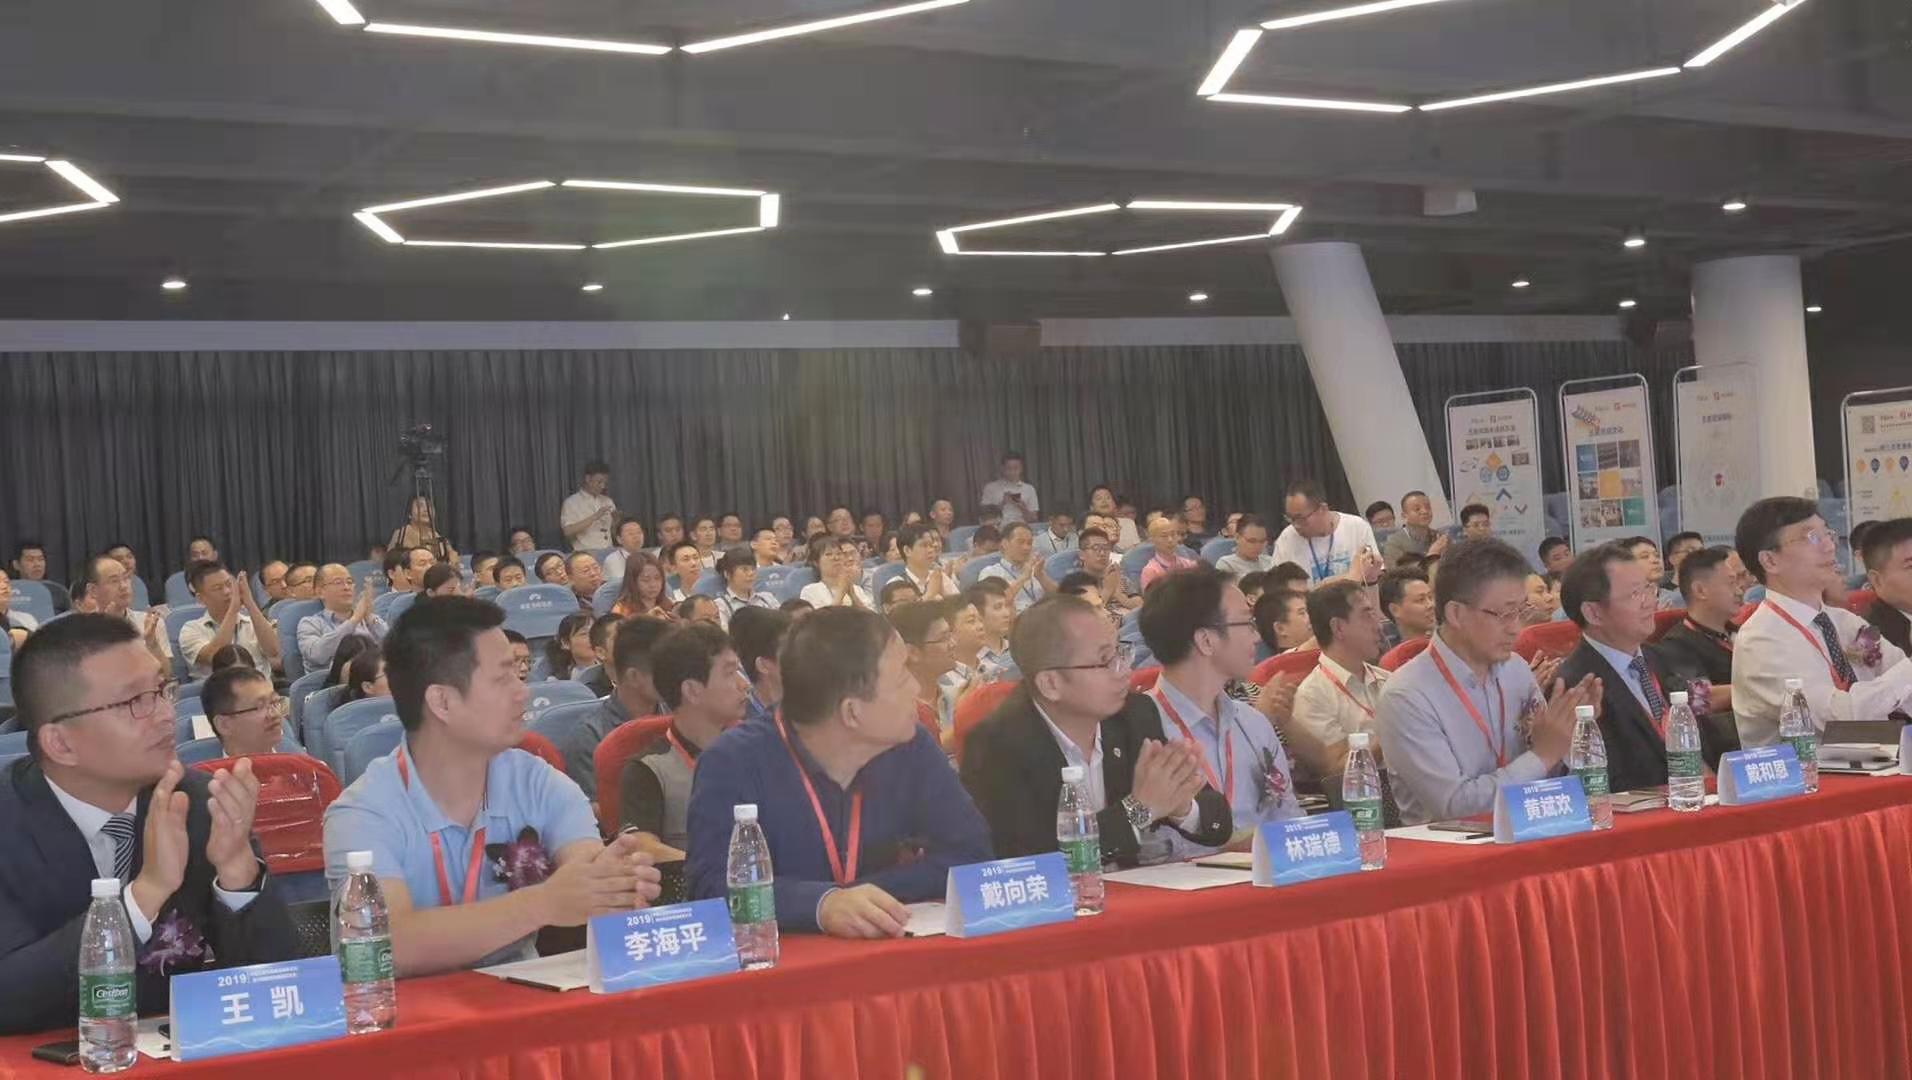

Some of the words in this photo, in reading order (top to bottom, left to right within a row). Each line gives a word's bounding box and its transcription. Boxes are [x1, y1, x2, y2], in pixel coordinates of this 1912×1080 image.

[1744, 759, 1789, 784] 戴和恩
[1285, 830, 1342, 862] 林瑞德
[980, 874, 1049, 909] 戴向荣
[626, 914, 651, 927] 2019
[624, 921, 707, 961] 李海平
[217, 973, 247, 988] 2019
